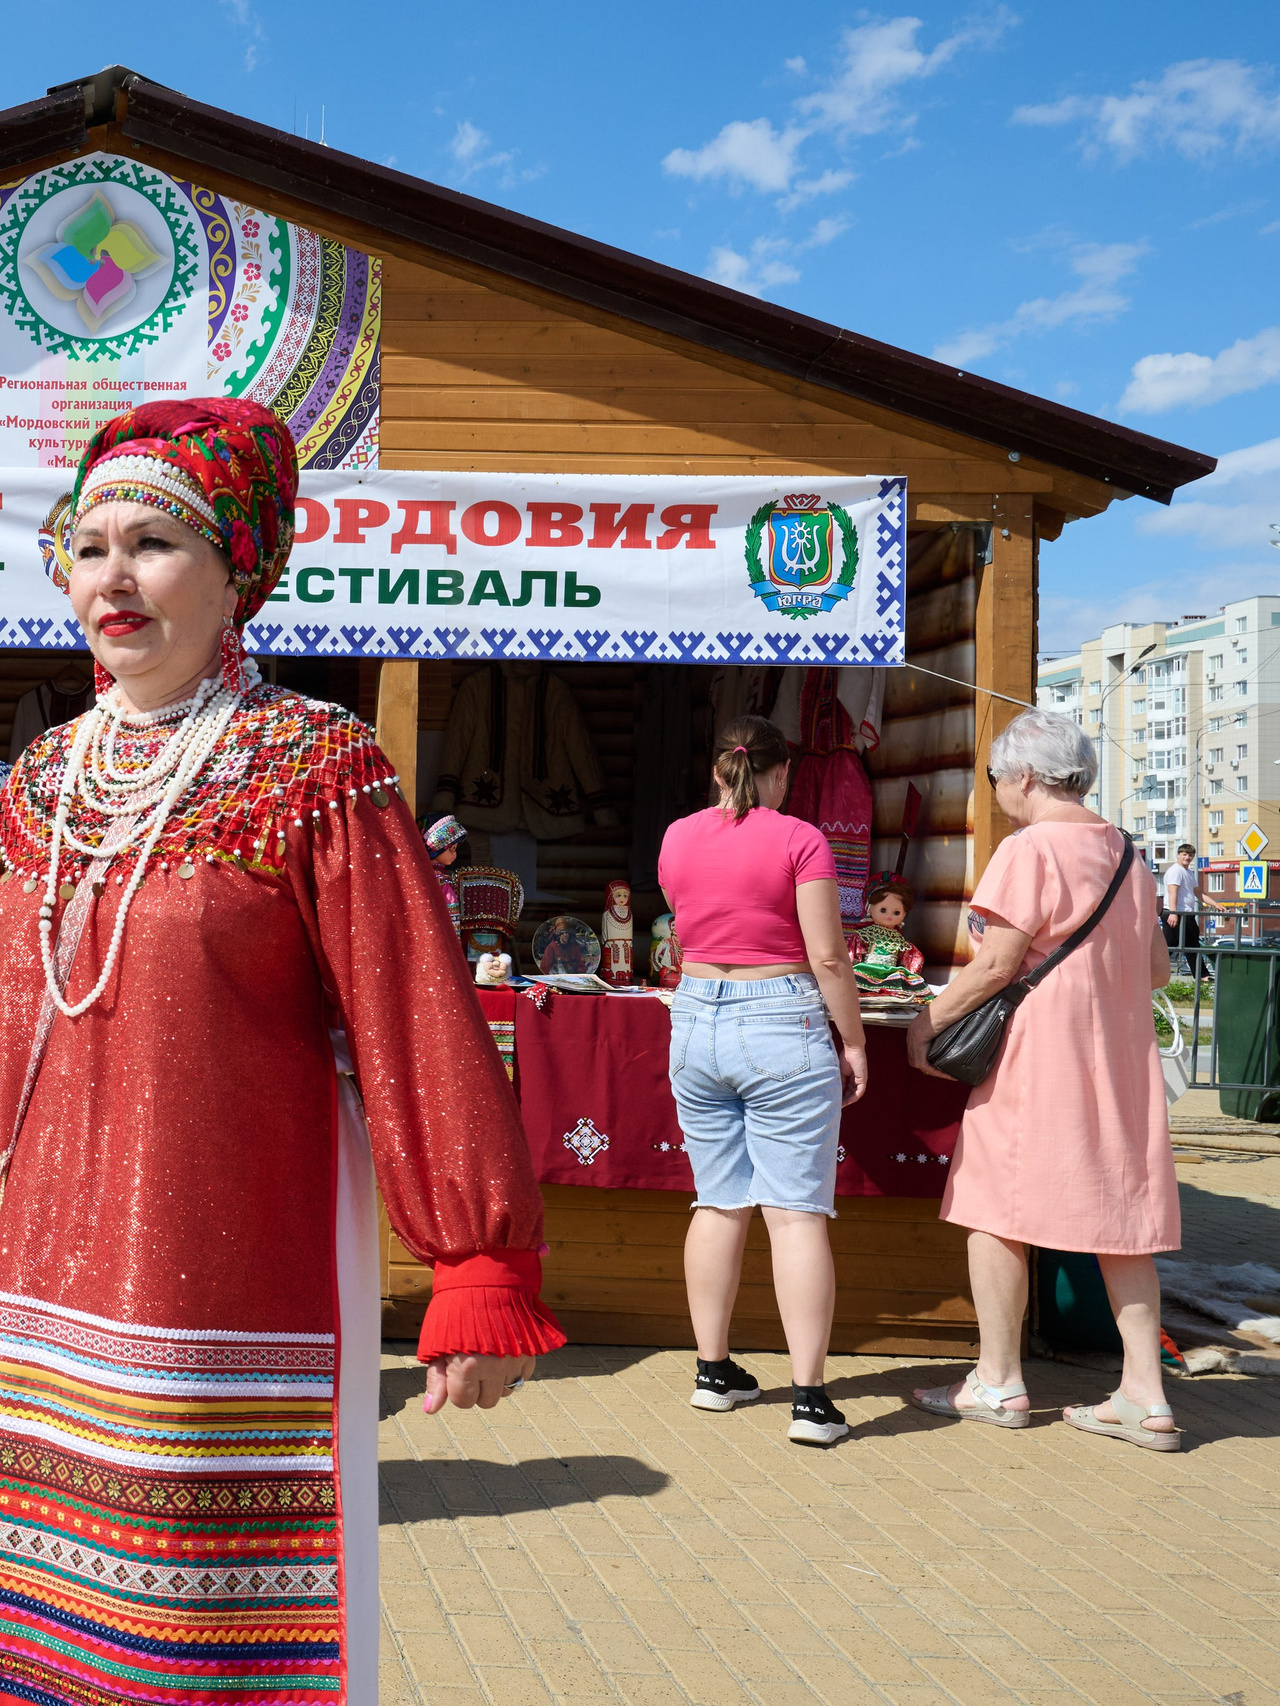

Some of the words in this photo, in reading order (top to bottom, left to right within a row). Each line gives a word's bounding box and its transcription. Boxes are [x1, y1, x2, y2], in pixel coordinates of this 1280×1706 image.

[0, 376, 87, 390] Региональная
[92, 378, 187, 392] общественная
[51, 400, 133, 412] организация
[0, 415, 90, 430] «Мордовский
[29, 438, 90, 451] культурн
[293, 497, 719, 555] ОРДОВИЯ
[266, 566, 601, 608] ЕСТИВАЛЬ
